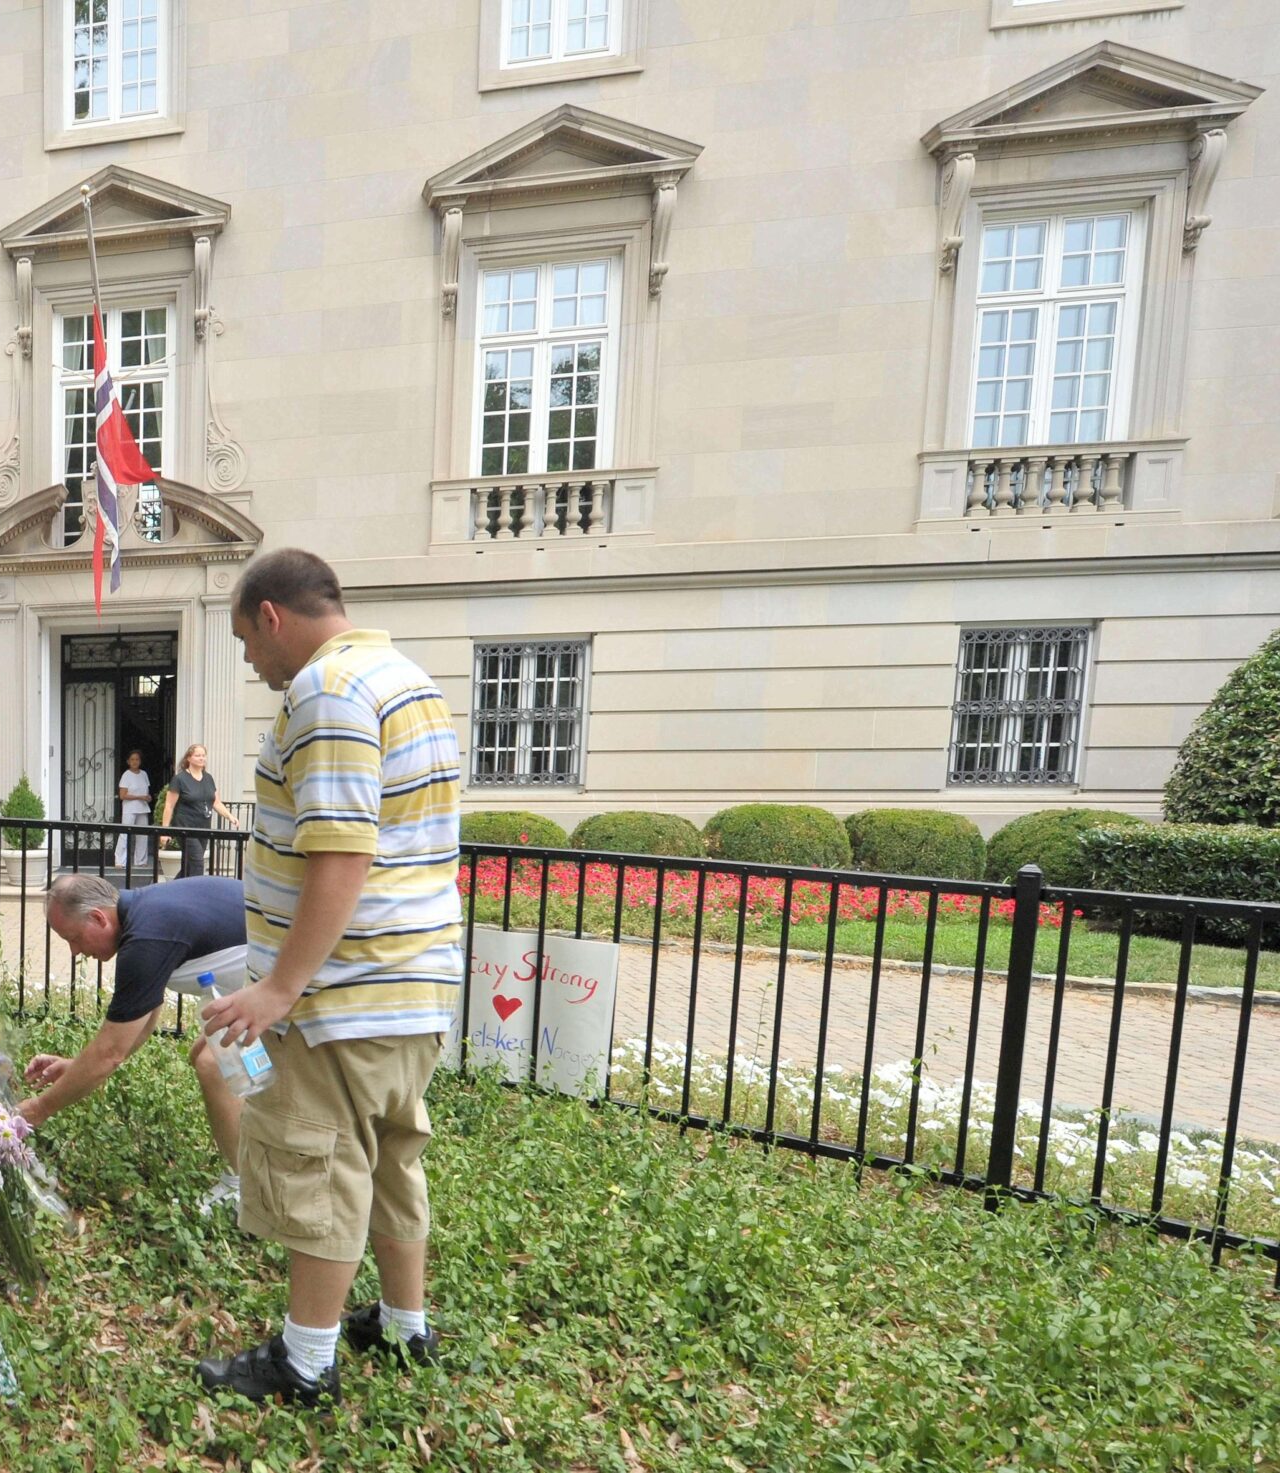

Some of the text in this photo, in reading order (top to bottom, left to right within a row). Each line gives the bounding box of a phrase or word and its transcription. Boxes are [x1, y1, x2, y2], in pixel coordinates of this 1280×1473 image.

[467, 950, 598, 1004] tay Strong
[471, 1022, 532, 1052] elsker
